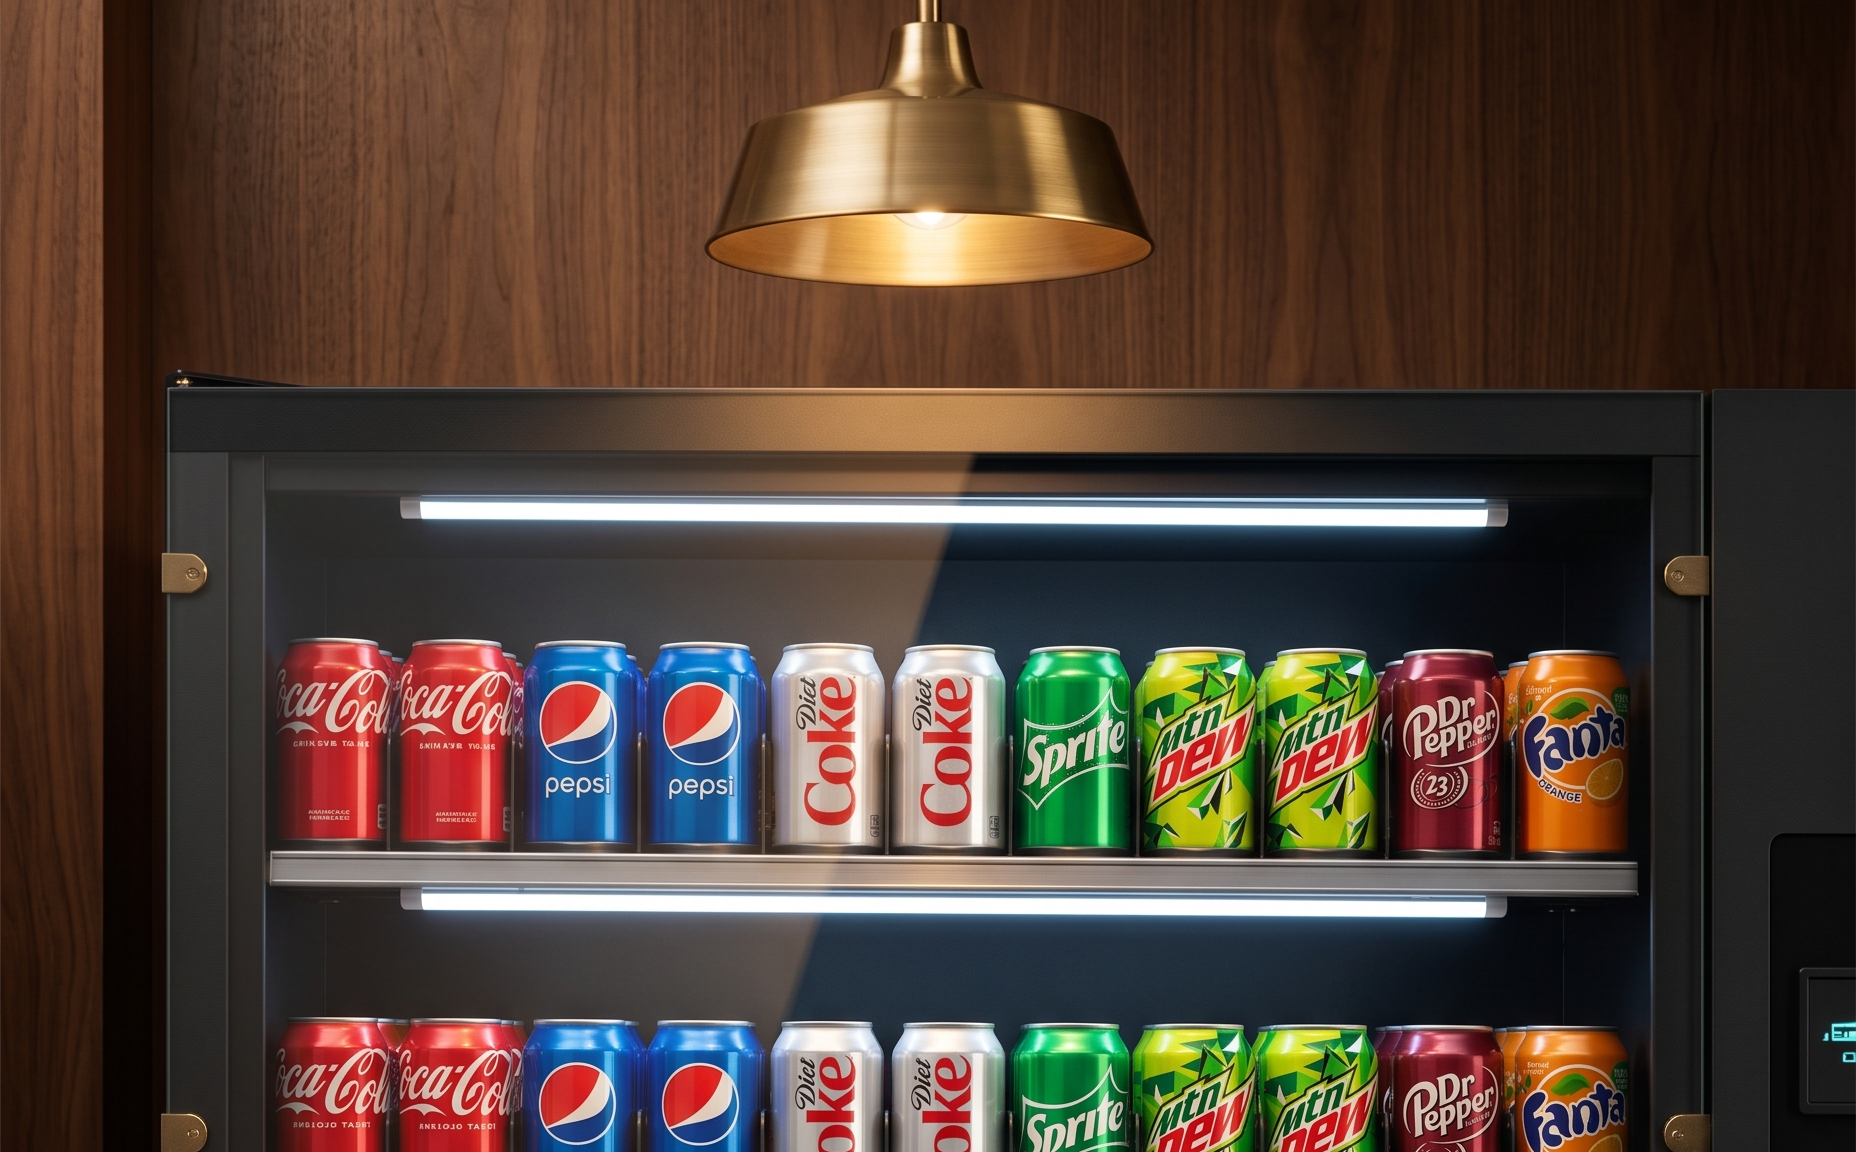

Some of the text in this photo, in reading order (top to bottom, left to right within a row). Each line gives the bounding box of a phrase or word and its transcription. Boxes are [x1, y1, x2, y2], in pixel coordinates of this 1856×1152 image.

[796, 676, 816, 730] Diet
[913, 678, 932, 731] Diet
[1437, 696, 1476, 728] Dr
[804, 676, 857, 826] Coke
[920, 677, 973, 827] Coke
[1023, 710, 1125, 789] Sprite
[1403, 705, 1497, 760] Pepper
[1524, 704, 1625, 779] Fanta
[545, 774, 610, 799] pepsi
[669, 775, 735, 800] pepsi
[1426, 775, 1448, 796] 23
[795, 1057, 816, 1110] Diet
[911, 1057, 931, 1111] Diet
[1403, 1081, 1495, 1138] Pepper
[1437, 1073, 1476, 1105] Dr
